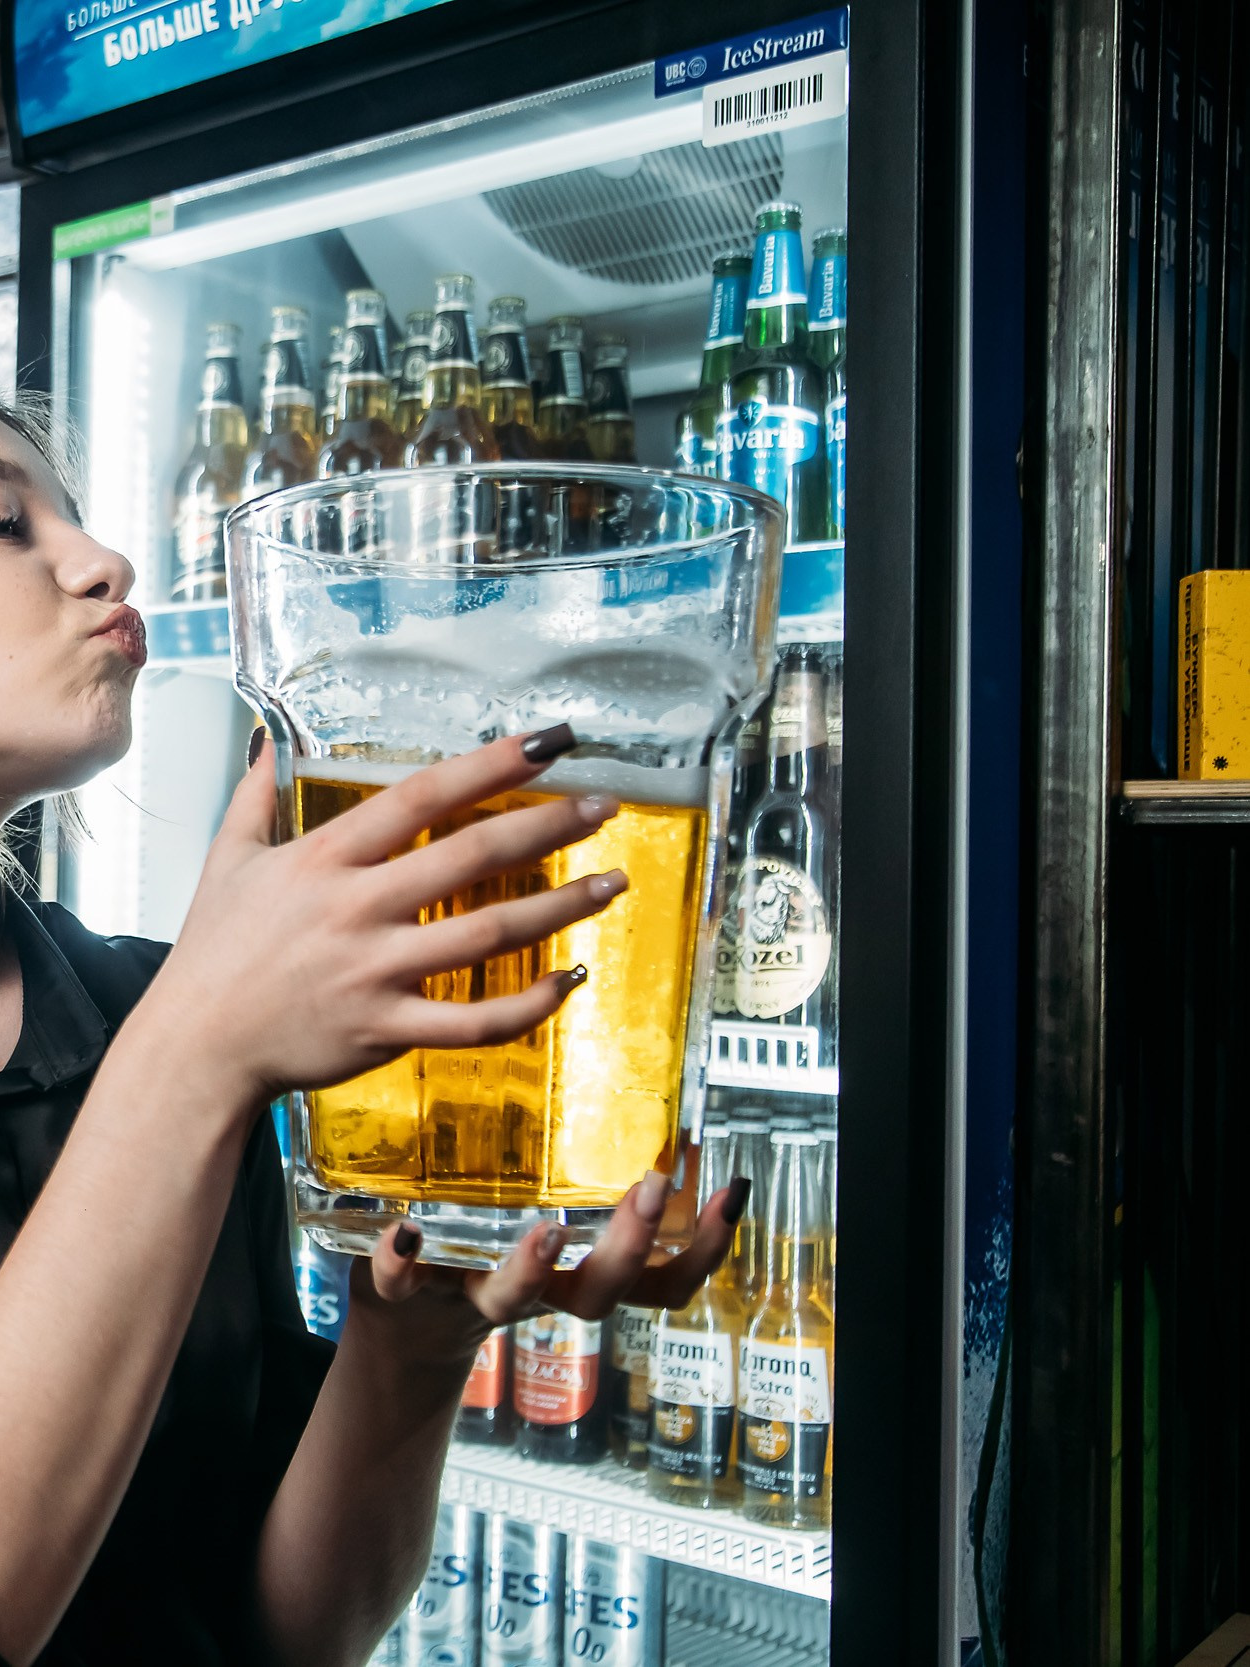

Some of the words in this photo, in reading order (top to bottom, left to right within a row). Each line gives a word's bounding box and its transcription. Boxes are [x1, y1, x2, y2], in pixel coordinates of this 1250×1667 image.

[103, 0, 220, 67] БОЛЬШЕ
[665, 61, 686, 80] UBC
[722, 28, 825, 72] IceStream
[747, 111, 788, 128] 310011212
[757, 234, 776, 295] Bavaria
[819, 260, 835, 319] Bavaria
[708, 283, 724, 338] Bavaria
[750, 1373, 794, 1396] Extra
